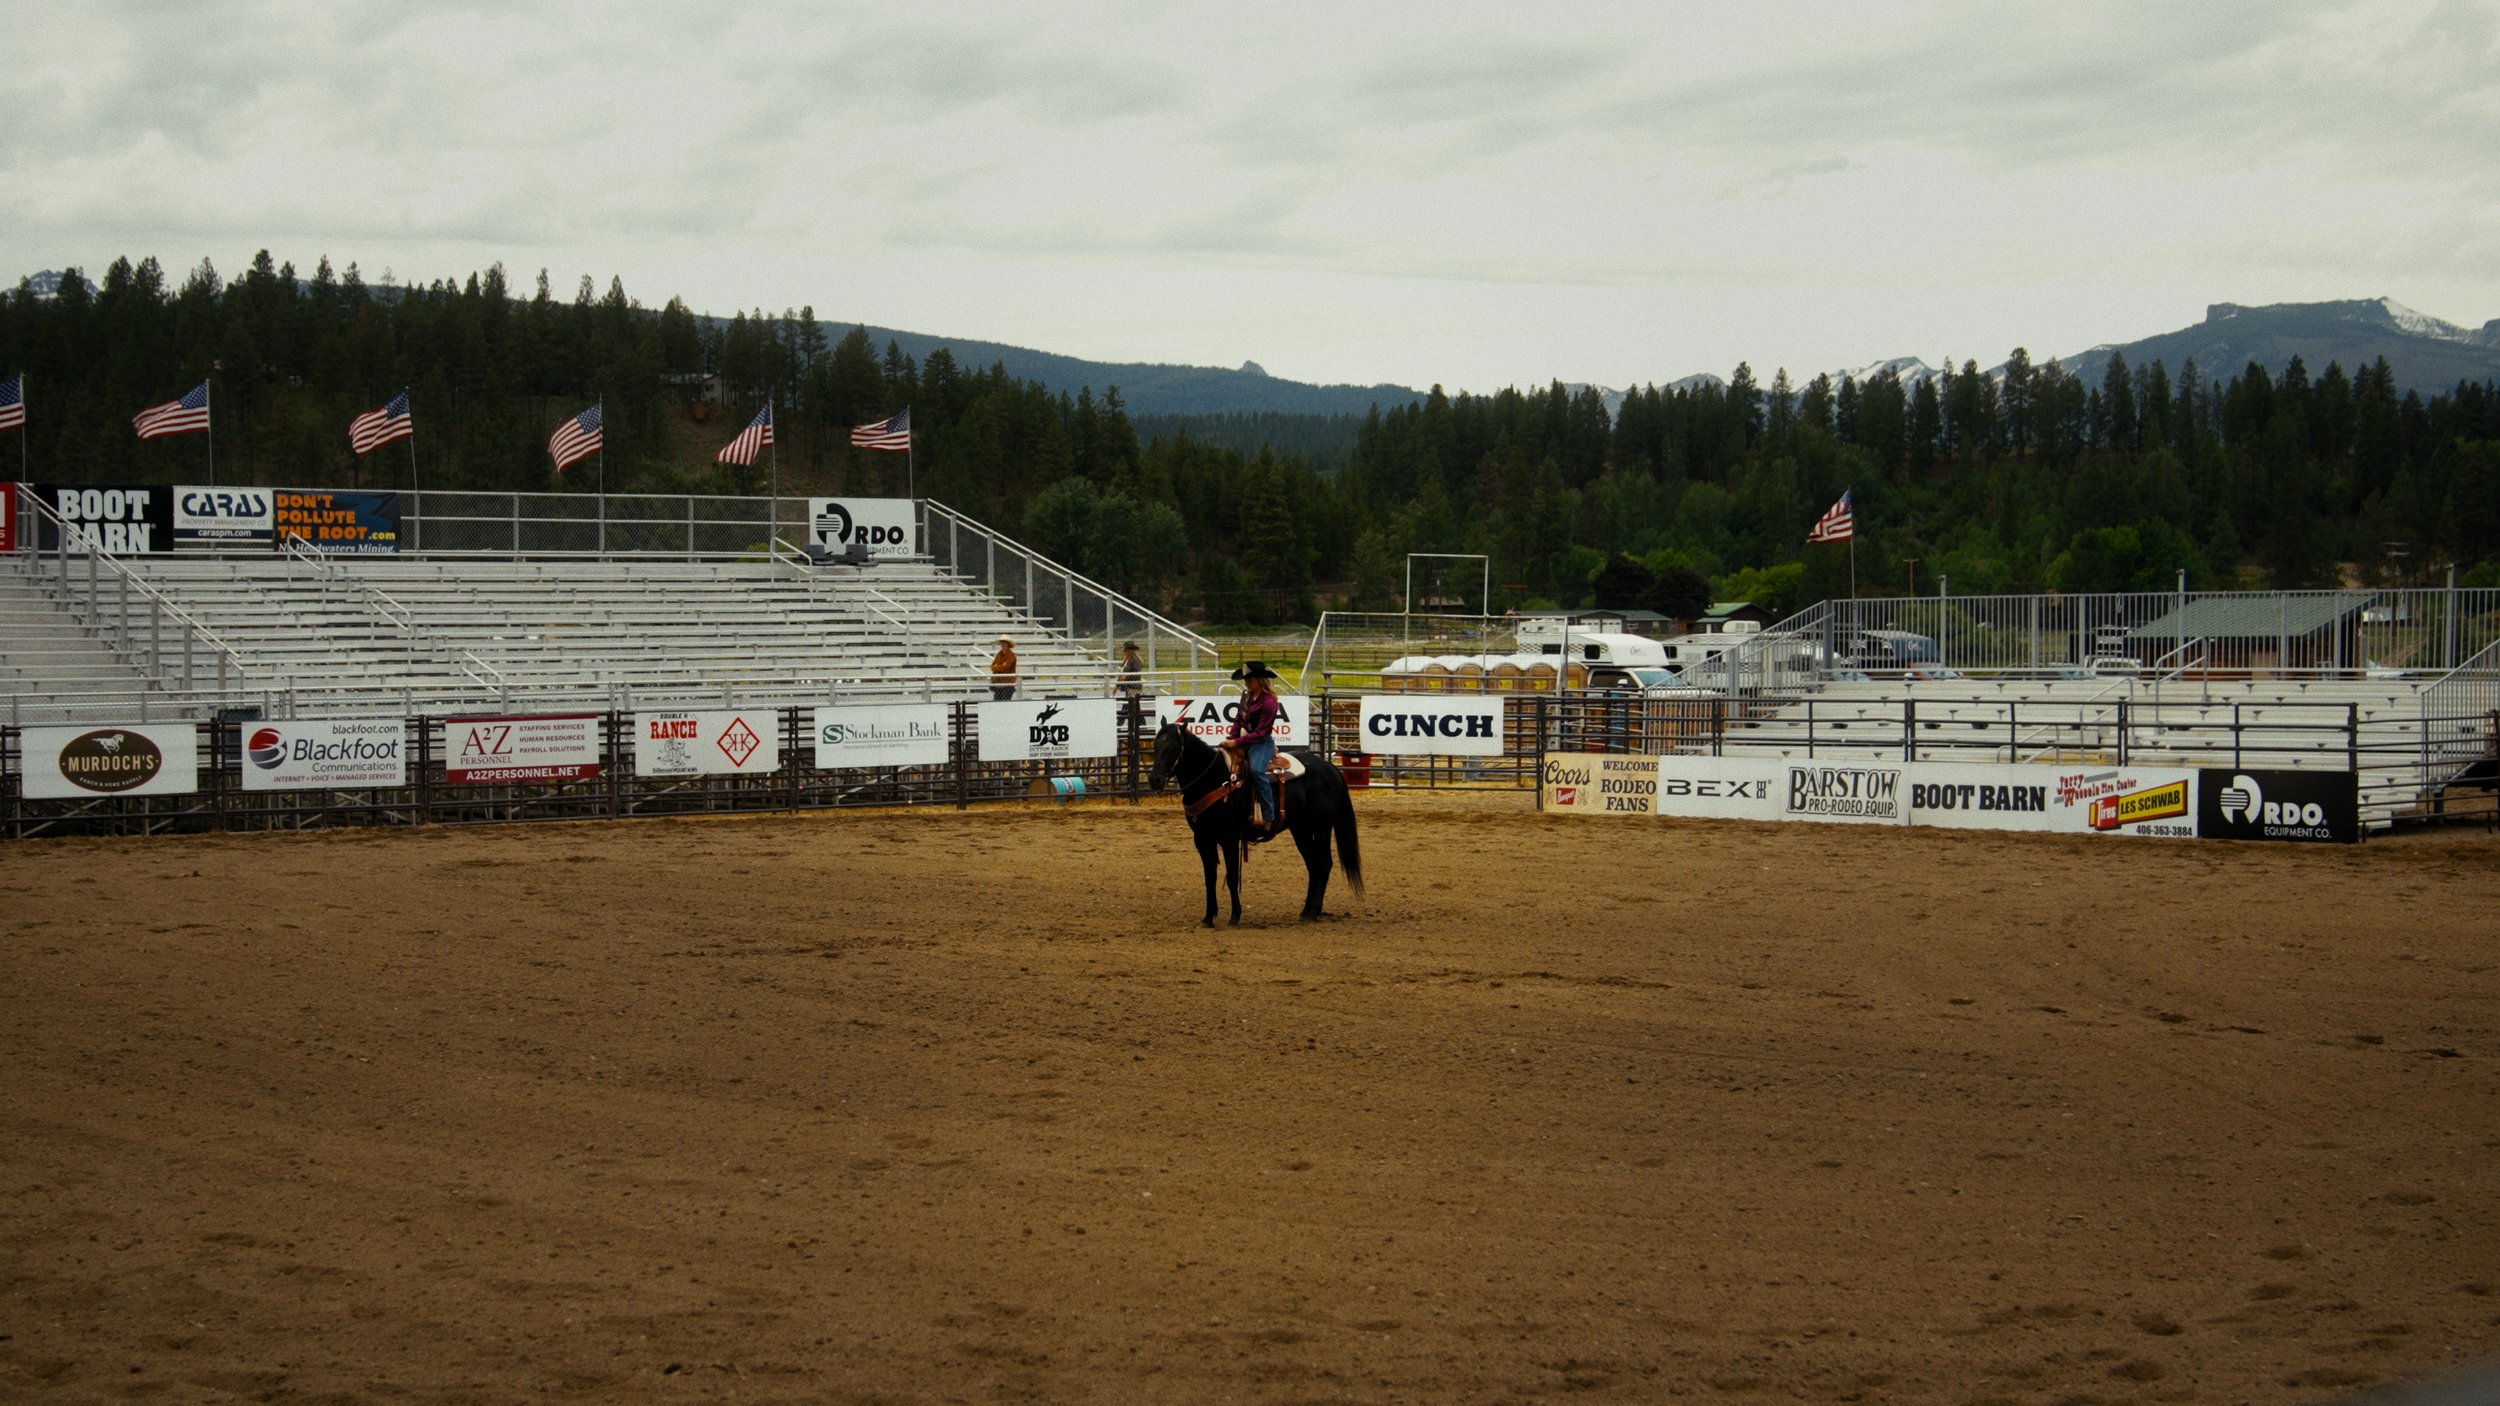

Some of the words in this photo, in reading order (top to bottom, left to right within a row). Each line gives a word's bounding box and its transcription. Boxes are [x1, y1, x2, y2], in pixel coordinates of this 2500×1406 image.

[57, 489, 150, 521] BOOT
[182, 493, 267, 517] CARAS
[276, 494, 333, 508] DON'T
[277, 510, 356, 524] POLLUTE
[198, 529, 252, 538] caraspm.com
[277, 526, 312, 539] THE
[855, 526, 904, 545] RDO
[358, 543, 395, 553] Mining.
[332, 724, 399, 735] blackfoot.com
[519, 724, 551, 732] STAFFING
[650, 721, 697, 739] RANCH
[845, 723, 905, 740] Stockman
[909, 721, 941, 738] Bank
[1368, 713, 1494, 737] CINCH
[519, 735, 544, 743] HUMAN
[293, 738, 398, 761] Blackfoot
[68, 755, 154, 772] MURDOCH'S
[312, 762, 397, 773] Communications
[460, 756, 513, 765] PERSONNEL
[1602, 760, 1659, 772] WELCOME
[335, 773, 368, 781] MANAGED
[466, 766, 581, 780] A2ZPERSONNEL.NET
[1544, 760, 1591, 785] Coors
[1600, 779, 1657, 795] RODEO
[1666, 779, 1752, 798] BEX
[1788, 769, 1896, 811] BARSTOW
[2057, 774, 2084, 795] Jerry
[1605, 796, 1649, 812] FANS
[1912, 783, 1975, 809] BOOT
[1979, 785, 2046, 811] BARN
[2121, 800, 2136, 815] LES
[2138, 790, 2180, 812] SCHWAB
[1808, 798, 1863, 813] PRO-RODEO
[1865, 801, 1895, 816] EQUIP.
[2097, 800, 2117, 827] Tires
[2264, 801, 2323, 826] RDO
[2136, 825, 2192, 836] 406-363-3884
[2264, 826, 2313, 838] EQUIPMENT
[2315, 828, 2332, 839] CO.
